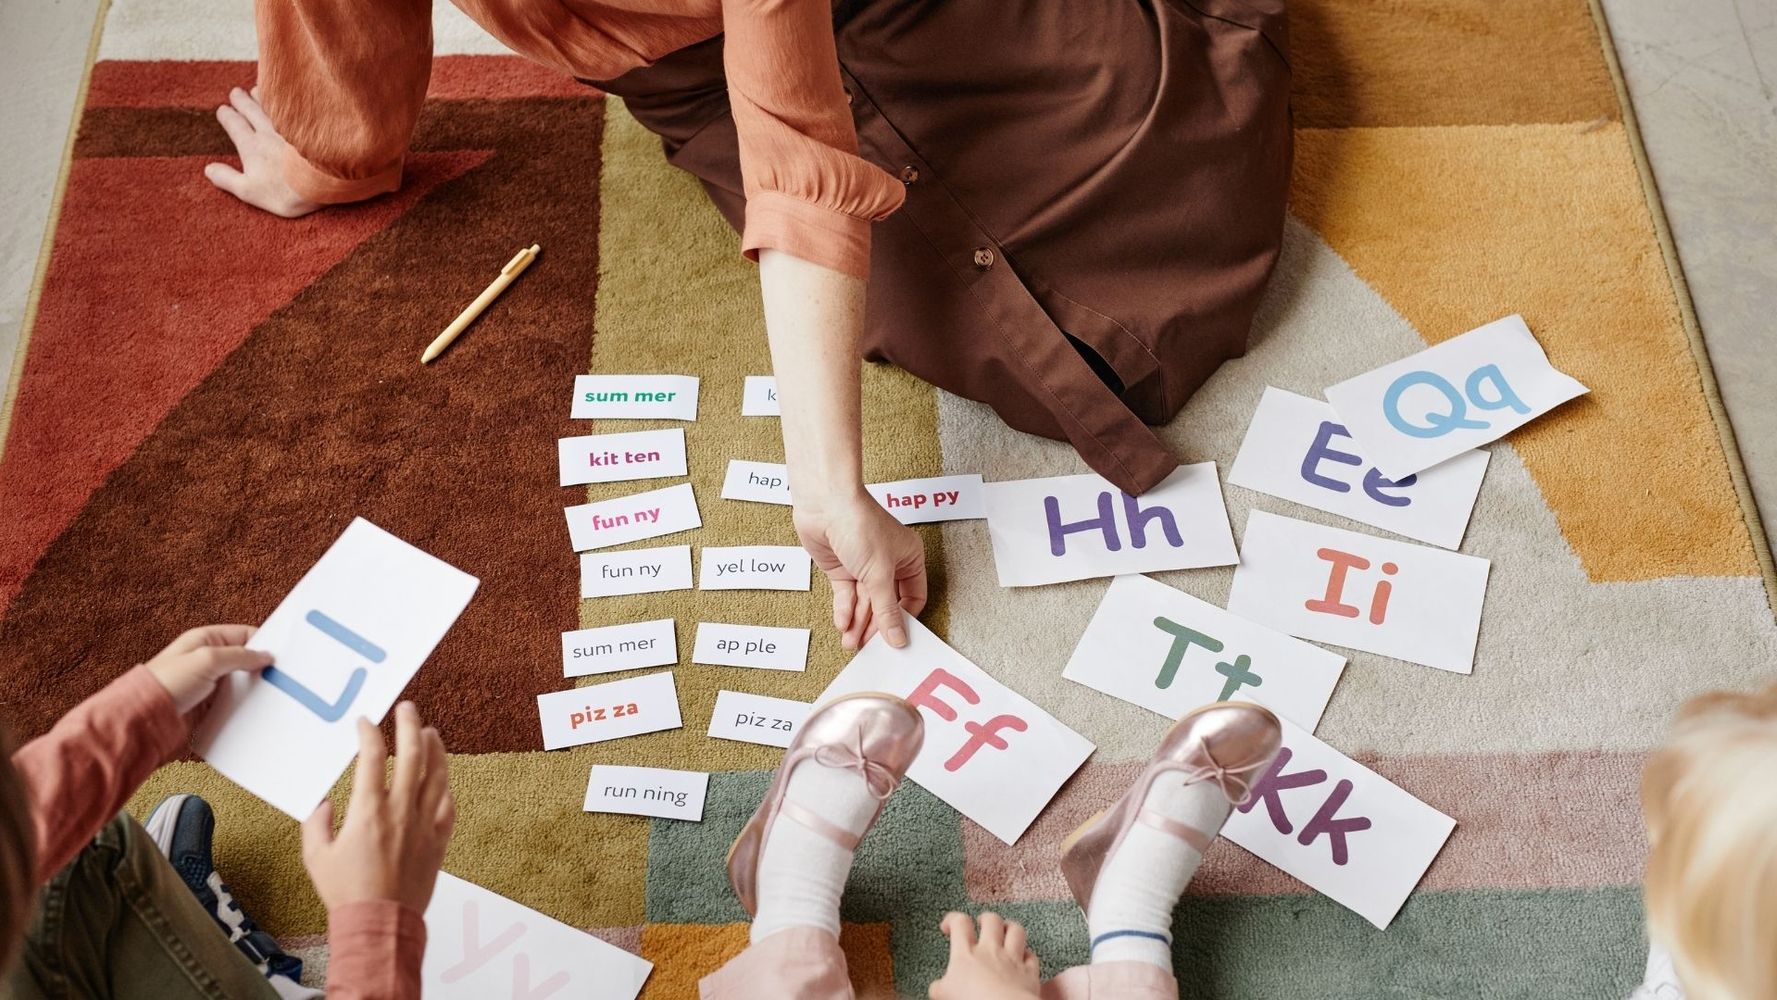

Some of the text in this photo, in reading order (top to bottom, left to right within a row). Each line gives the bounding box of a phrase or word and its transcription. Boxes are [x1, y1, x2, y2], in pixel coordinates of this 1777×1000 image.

[584, 391, 677, 403] sum mer
[1383, 364, 1531, 439] Qq
[589, 451, 661, 467] kit ten
[1300, 420, 1418, 507] Ee
[748, 471, 782, 490] hap
[887, 490, 960, 509] hap py
[592, 507, 661, 531] fun ny
[1043, 491, 1184, 557] Hh
[602, 563, 662, 579] fun ny
[716, 558, 786, 577] yel low
[1304, 547, 1400, 626] Ii
[572, 637, 657, 659] sum mer
[716, 637, 777, 656] ap ple
[1152, 616, 1262, 702] Tt
[569, 701, 639, 730] piz za
[734, 710, 793, 732] piz za
[906, 667, 1028, 772] Ff
[603, 783, 688, 807] run ning
[1236, 746, 1372, 866] Kk
